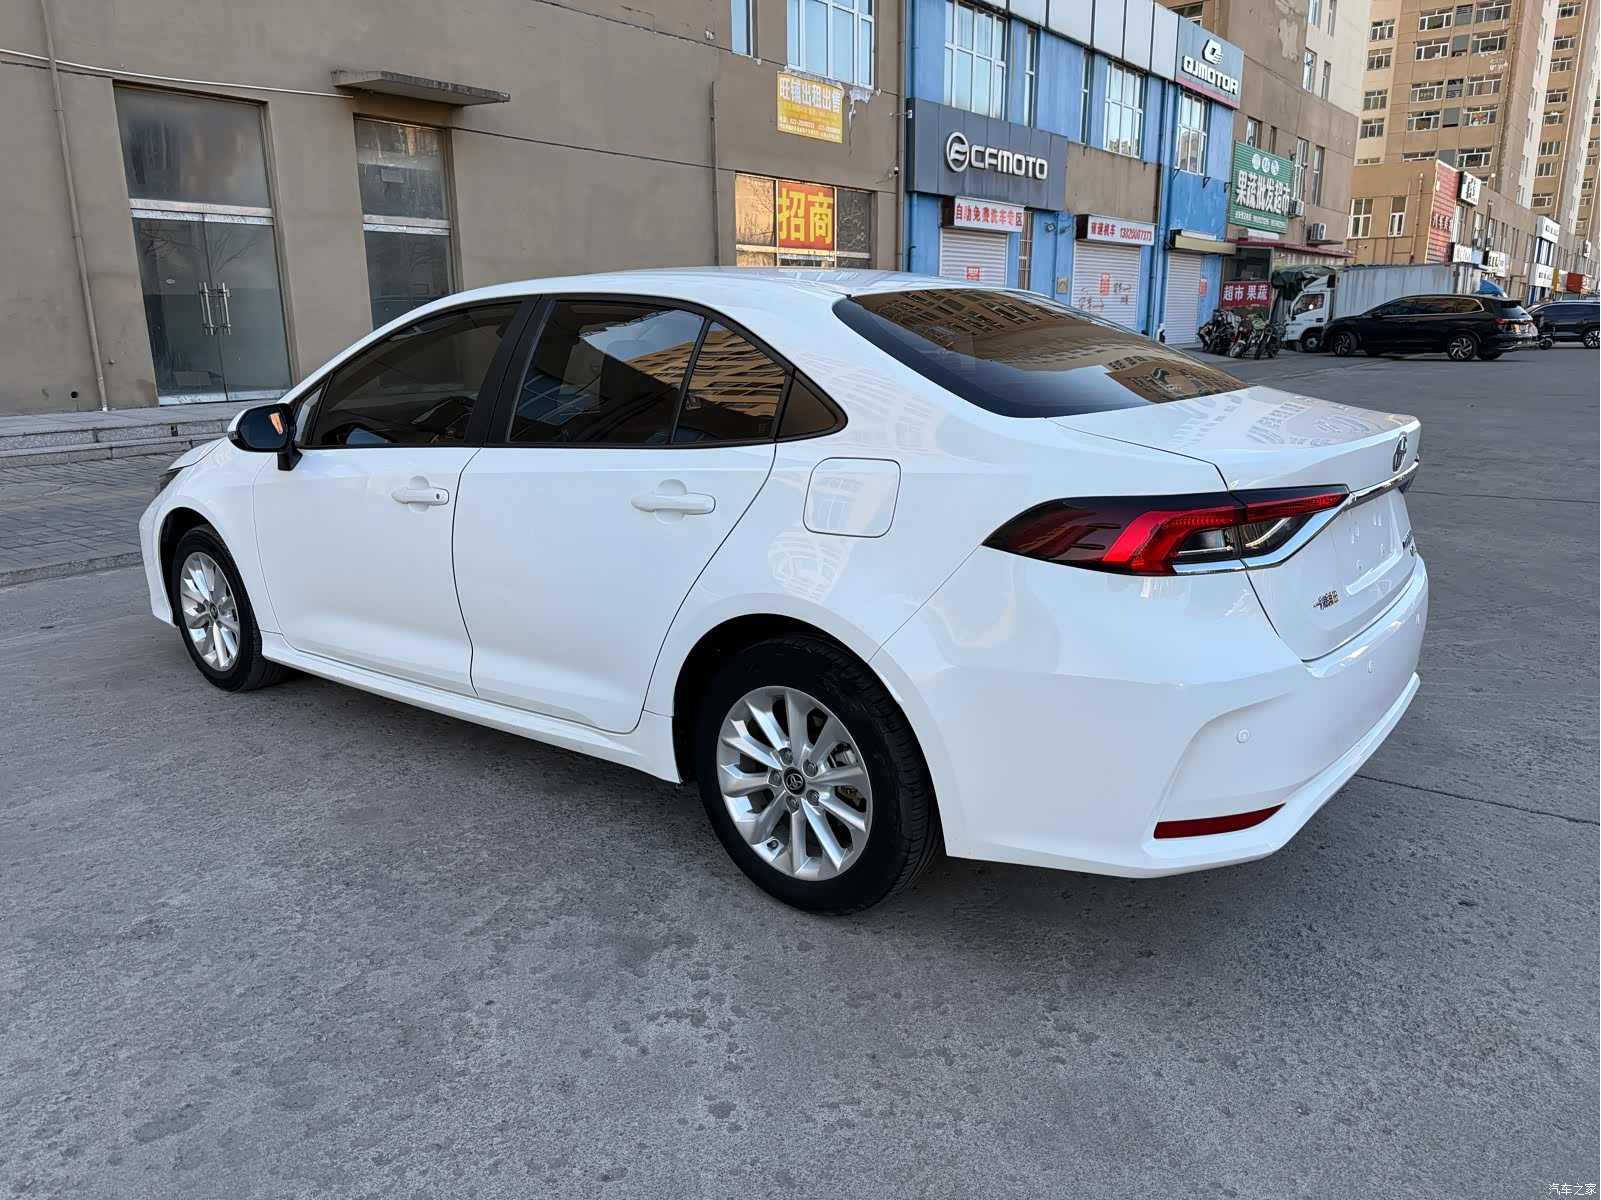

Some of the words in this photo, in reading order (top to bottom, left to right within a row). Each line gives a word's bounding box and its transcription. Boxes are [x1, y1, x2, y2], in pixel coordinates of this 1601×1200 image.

[1183, 55, 1239, 95] QJMOTOR
[779, 77, 841, 113] 旺铺出租出售
[970, 144, 1048, 180] CFMOTO
[1235, 170, 1291, 216] 果蔬批发超市
[778, 187, 834, 245] 招商
[1223, 285, 1244, 301] 超市
[1246, 284, 1268, 300] 果蔬
